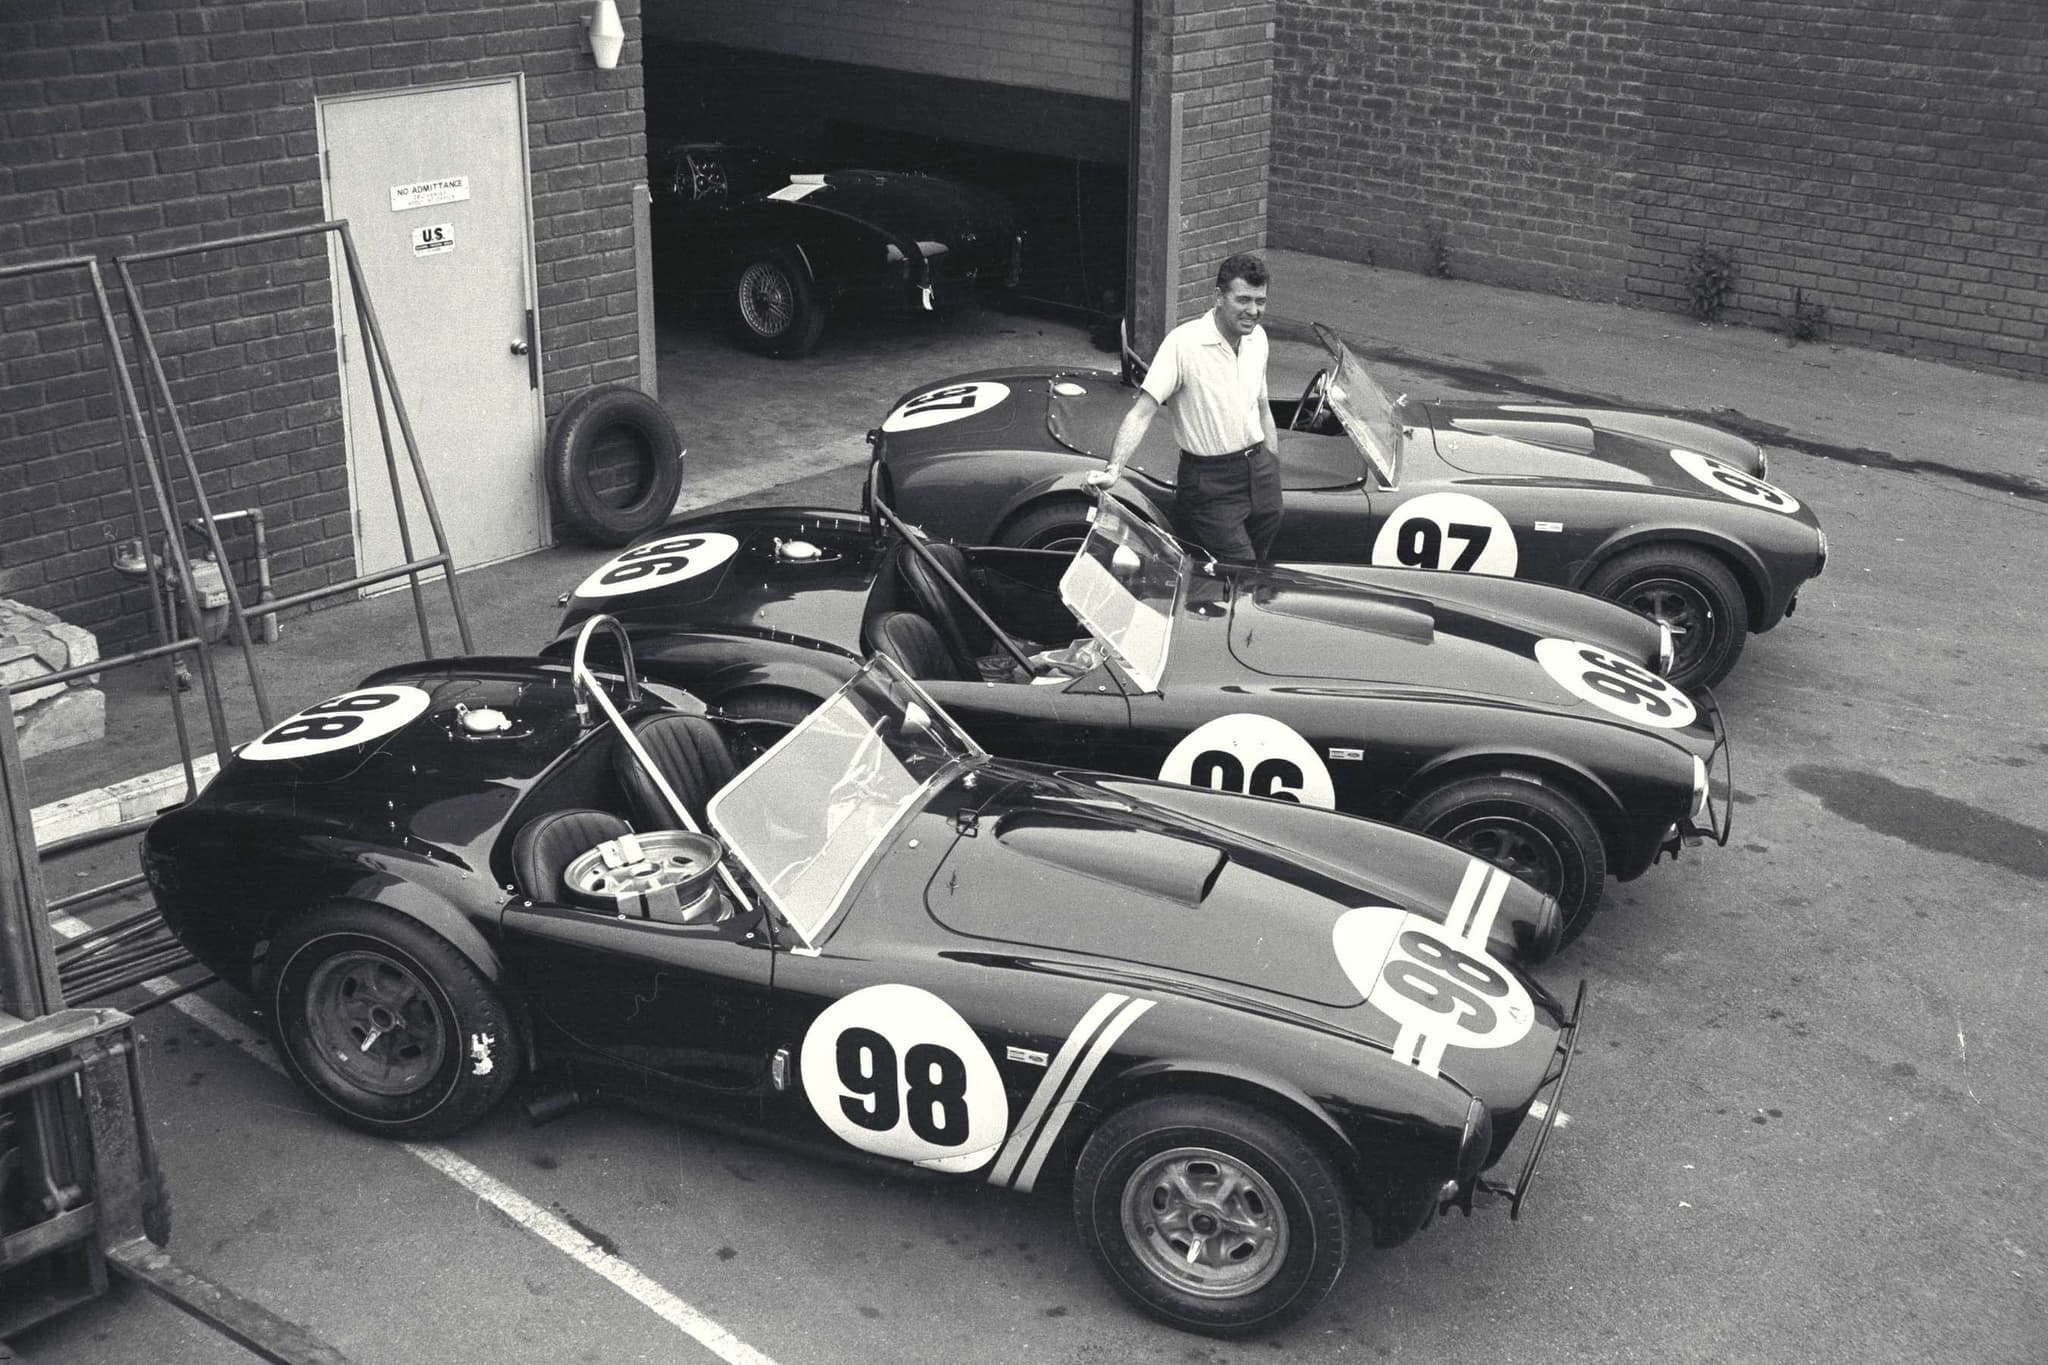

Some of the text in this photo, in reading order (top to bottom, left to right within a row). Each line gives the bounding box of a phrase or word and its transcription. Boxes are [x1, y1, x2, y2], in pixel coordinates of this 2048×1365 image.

[397, 188, 408, 196] NO
[412, 180, 462, 193] ADMITTANCE
[422, 227, 445, 242] U.S.
[903, 386, 979, 418] 97
[600, 538, 706, 585] 96
[1396, 516, 1493, 572] 97
[1578, 649, 1672, 717] 96
[261, 693, 401, 745] 98
[1382, 930, 1510, 1035] 98
[836, 1026, 970, 1147] 98
